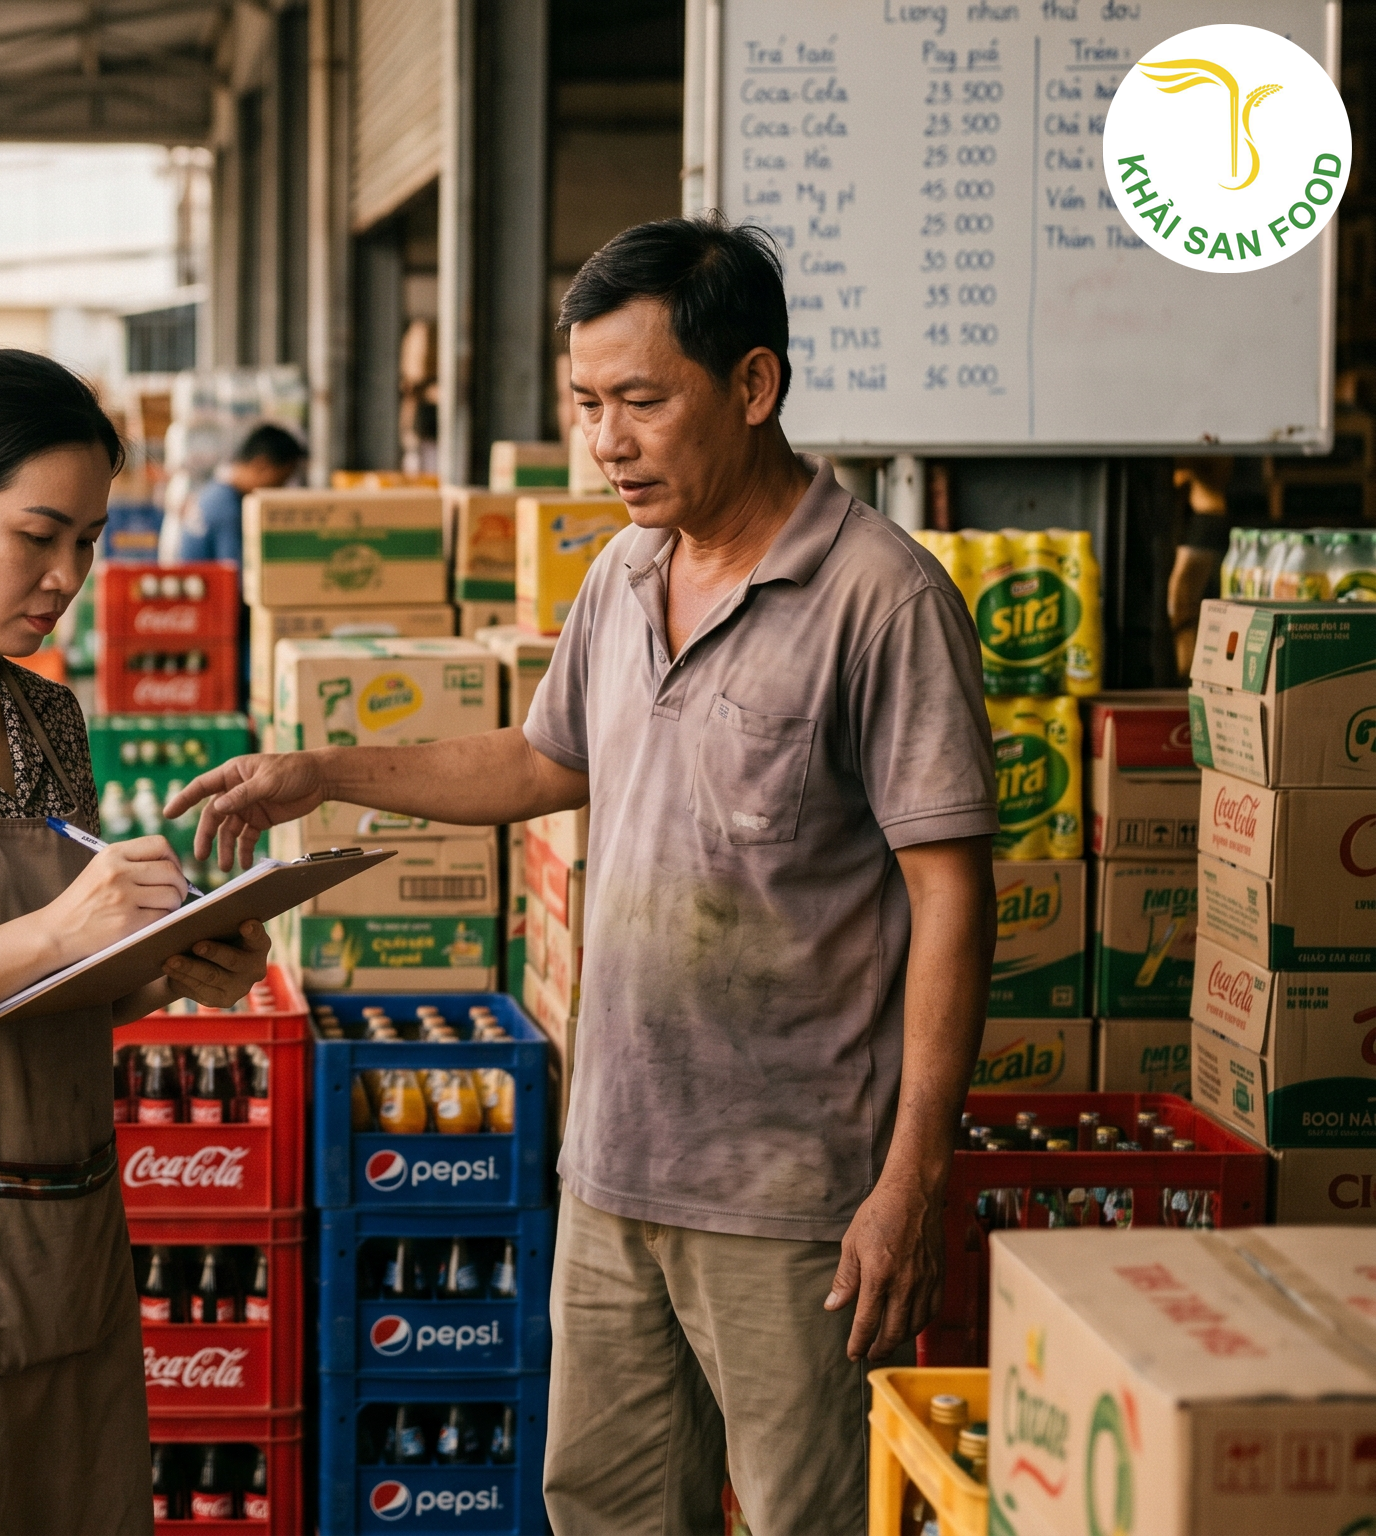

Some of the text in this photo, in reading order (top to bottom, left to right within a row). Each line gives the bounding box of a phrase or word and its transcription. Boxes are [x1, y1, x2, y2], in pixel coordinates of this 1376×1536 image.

[740, 77, 848, 104] Coca-Cola
[740, 112, 848, 139] Coca-Cola
[123, 1145, 250, 1188] Coca-Cola
[411, 1156, 495, 1187] pepsi
[416, 1320, 499, 1352] pepsi
[415, 1486, 498, 1517] pepsi
